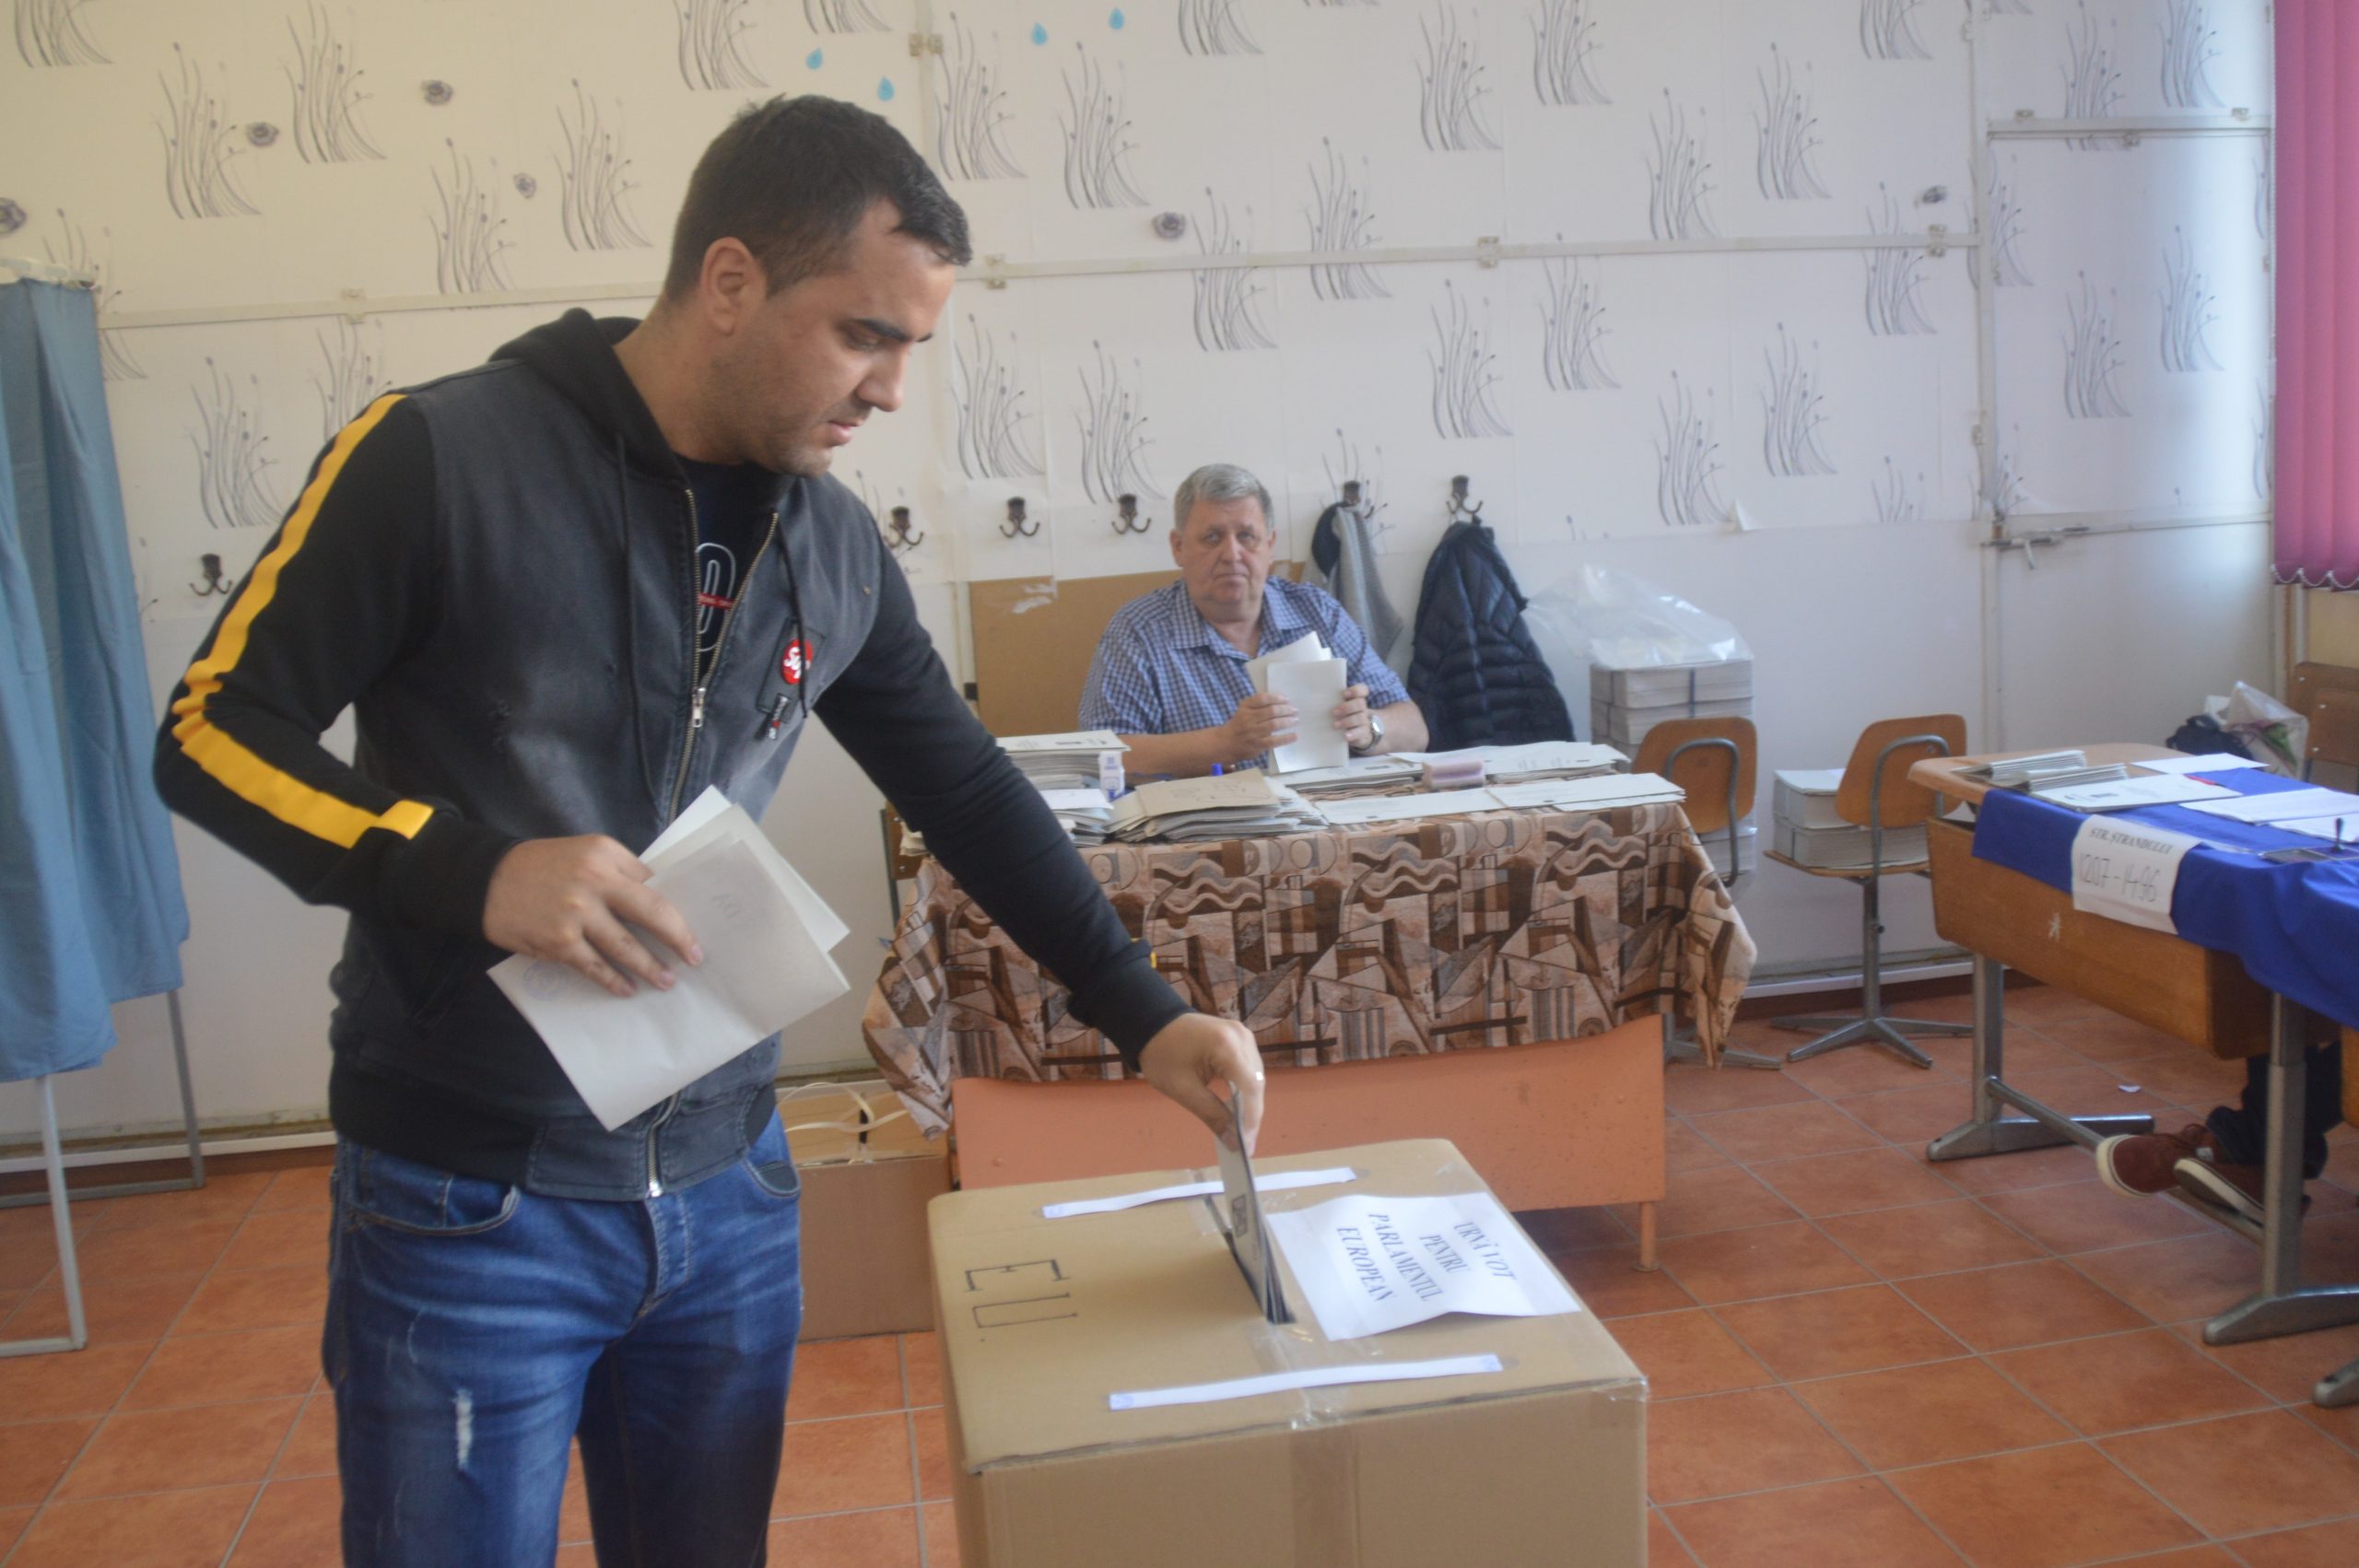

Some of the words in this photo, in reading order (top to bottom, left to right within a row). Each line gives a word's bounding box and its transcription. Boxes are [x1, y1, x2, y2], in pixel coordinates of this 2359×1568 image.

[1336, 1225, 1397, 1303] EUROPEAN
[1367, 1212, 1444, 1303] PARLAMENTUL
[1419, 1233, 1472, 1275] PENTRU
[1453, 1220, 1499, 1251] URNĂ
[1483, 1251, 1518, 1281] VOT
